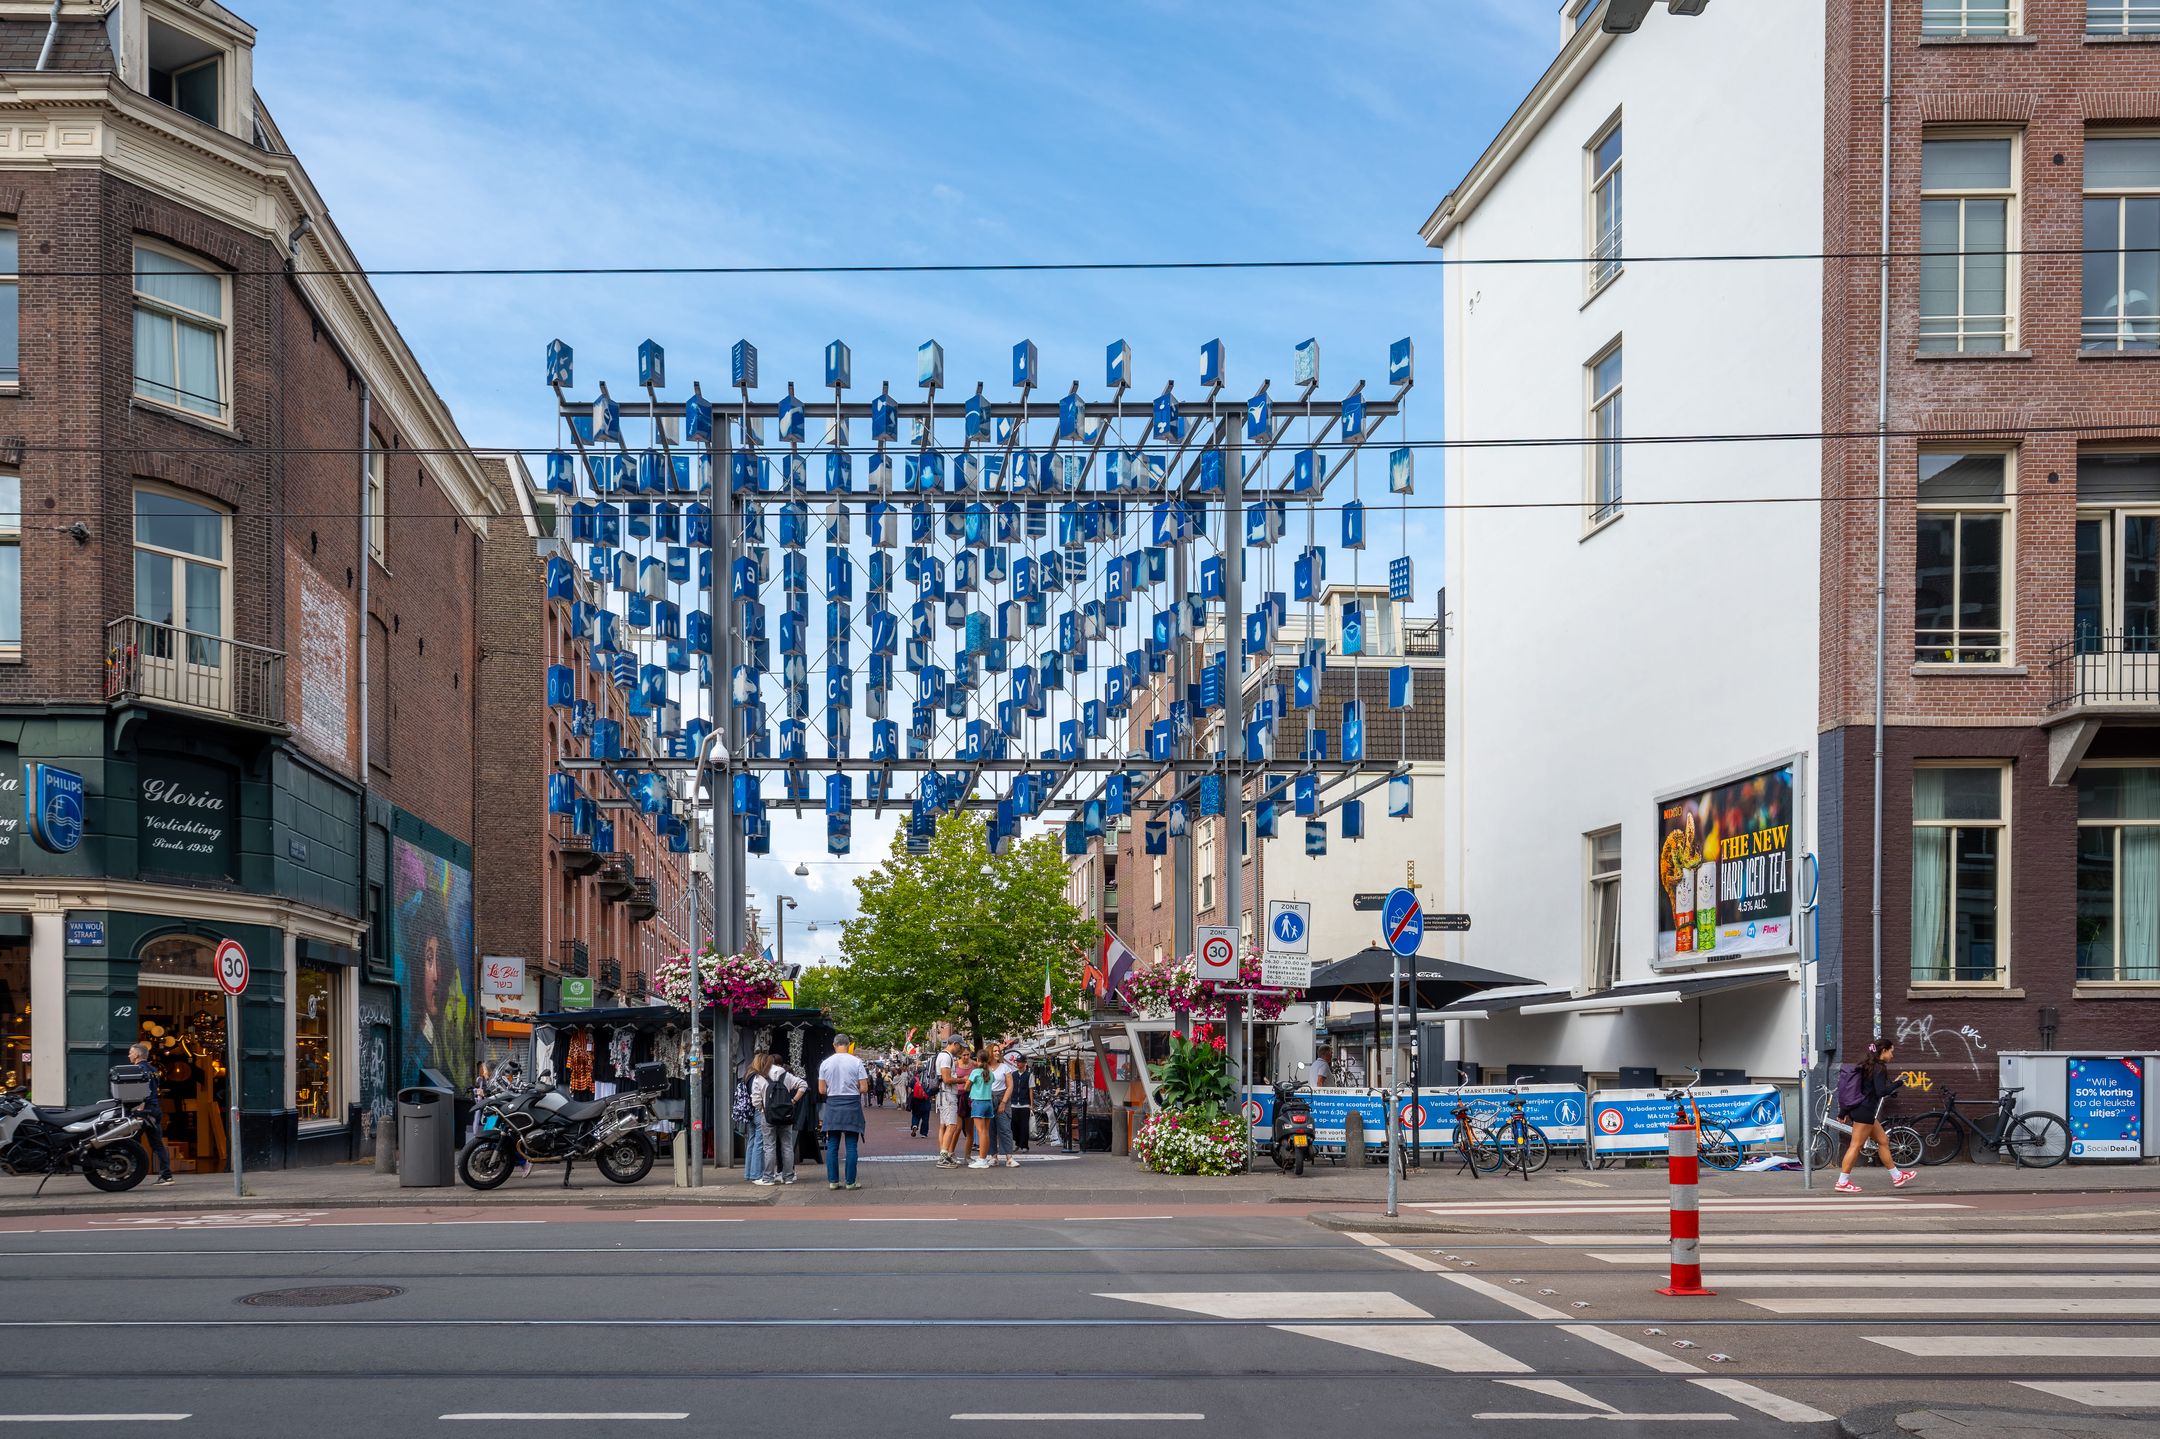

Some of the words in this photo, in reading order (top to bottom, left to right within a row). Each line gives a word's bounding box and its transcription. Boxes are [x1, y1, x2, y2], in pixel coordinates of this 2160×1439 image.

[46, 774, 82, 794] PHILIPS
[142, 778, 224, 810] Gloria
[144, 815, 223, 841] Verlichting
[152, 837, 184, 851] Sinds
[186, 843, 215, 854] 1938
[1721, 833, 1749, 860] THE
[1752, 824, 1789, 854] NEW
[1721, 859, 1744, 902] HARD
[1745, 855, 1766, 898] ICED
[1769, 851, 1787, 894] TEA
[1738, 901, 1754, 913] 4.5%
[1754, 899, 1768, 910] ALC.
[70, 922, 83, 930] VAN
[1763, 923, 1779, 934] Flink
[1209, 946, 1227, 958] 30
[224, 957, 244, 978] 30
[114, 1006, 132, 1017] 12
[2125, 1061, 2138, 1073] -50%
[2108, 1078, 2118, 1088] je
[2075, 1089, 2098, 1097] 50%
[2099, 1088, 2134, 1098] korting
[2073, 1100, 2087, 1108] op
[2089, 1099, 2102, 1107] de
[2103, 1099, 2136, 1107] leukste
